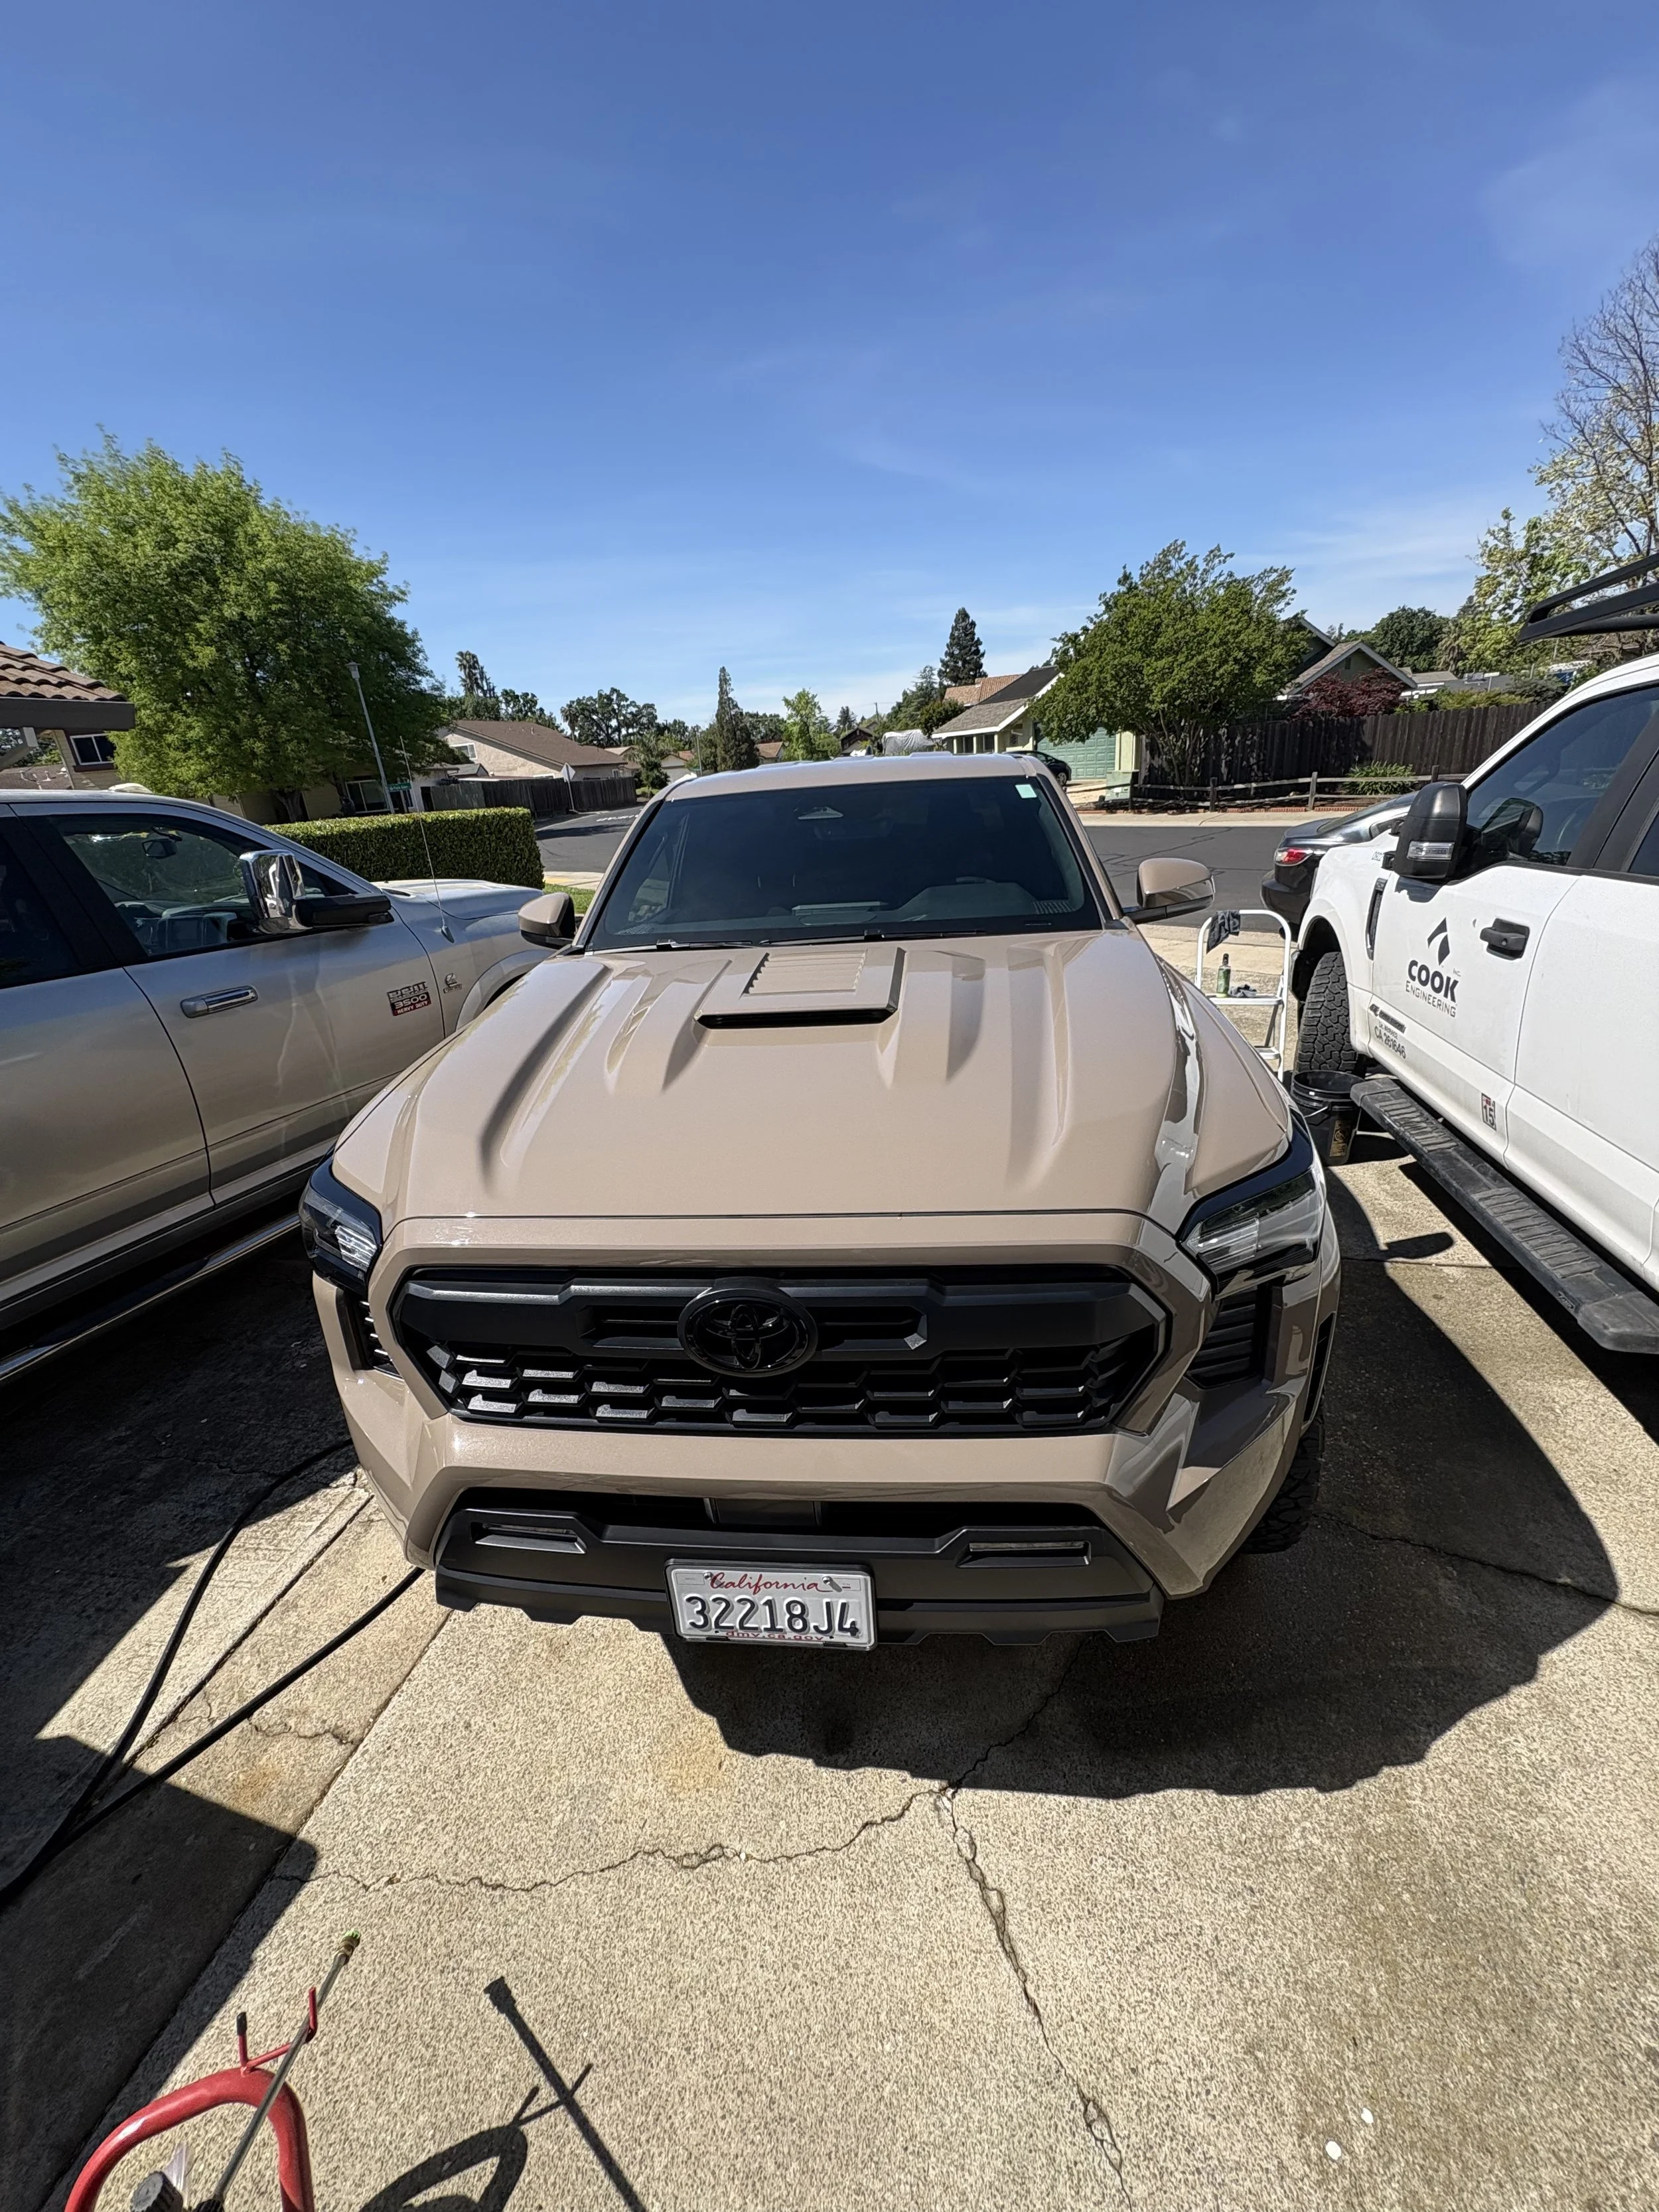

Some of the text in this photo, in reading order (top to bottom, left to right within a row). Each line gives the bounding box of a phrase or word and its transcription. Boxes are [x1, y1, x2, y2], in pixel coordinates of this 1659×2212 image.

[1407, 960, 1459, 1003] COOK
[394, 994, 427, 1009] 3500
[1406, 980, 1457, 1017] ENGINEERING
[397, 1005, 414, 1014] HEAVY
[1374, 1025, 1384, 1042] CA
[710, 1572, 833, 1595] California
[685, 1595, 860, 1637] 32218J4
[726, 1630, 824, 1642] dmv.ca.gov
